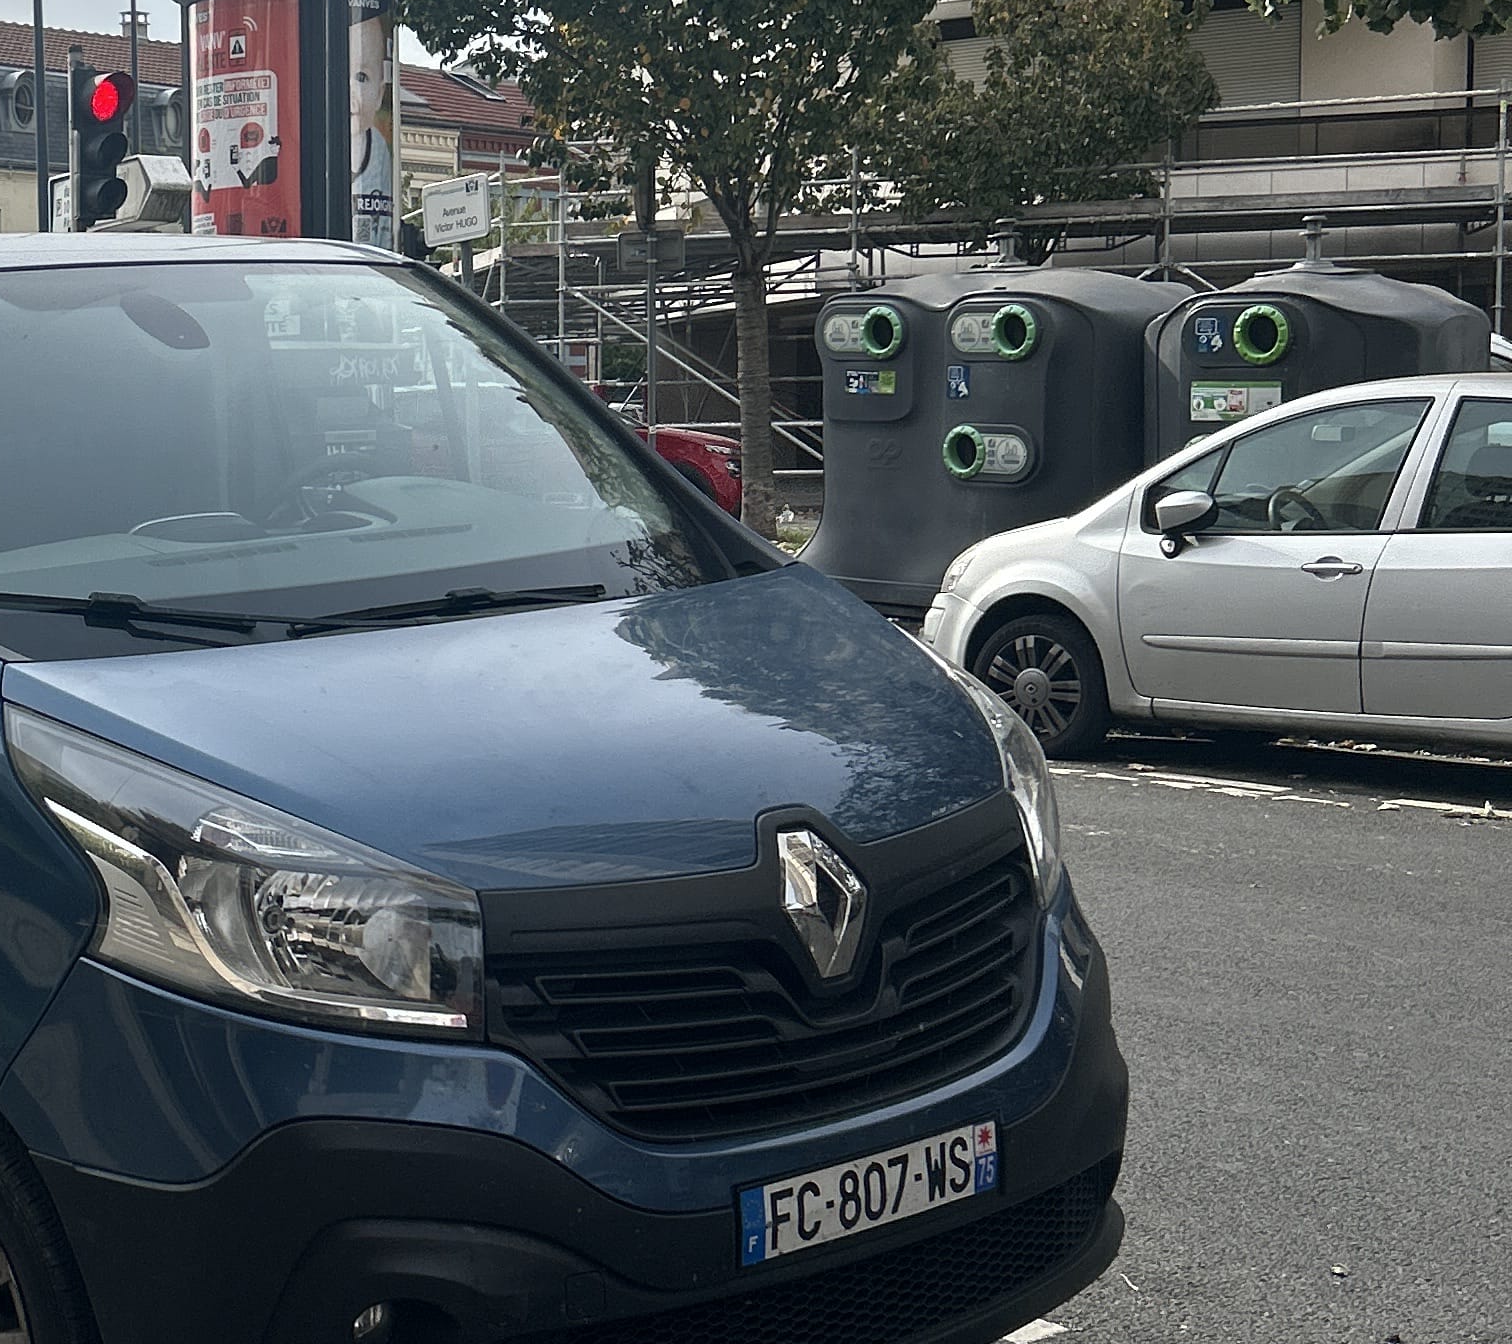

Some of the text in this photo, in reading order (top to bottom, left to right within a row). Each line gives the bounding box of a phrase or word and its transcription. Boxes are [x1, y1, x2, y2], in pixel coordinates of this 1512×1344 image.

[223, 92, 260, 105] SITUATION
[442, 206, 467, 217] Avenue
[434, 216, 478, 233] Victor HUGO
[747, 1136, 995, 1253] F FC-807-WS 75
